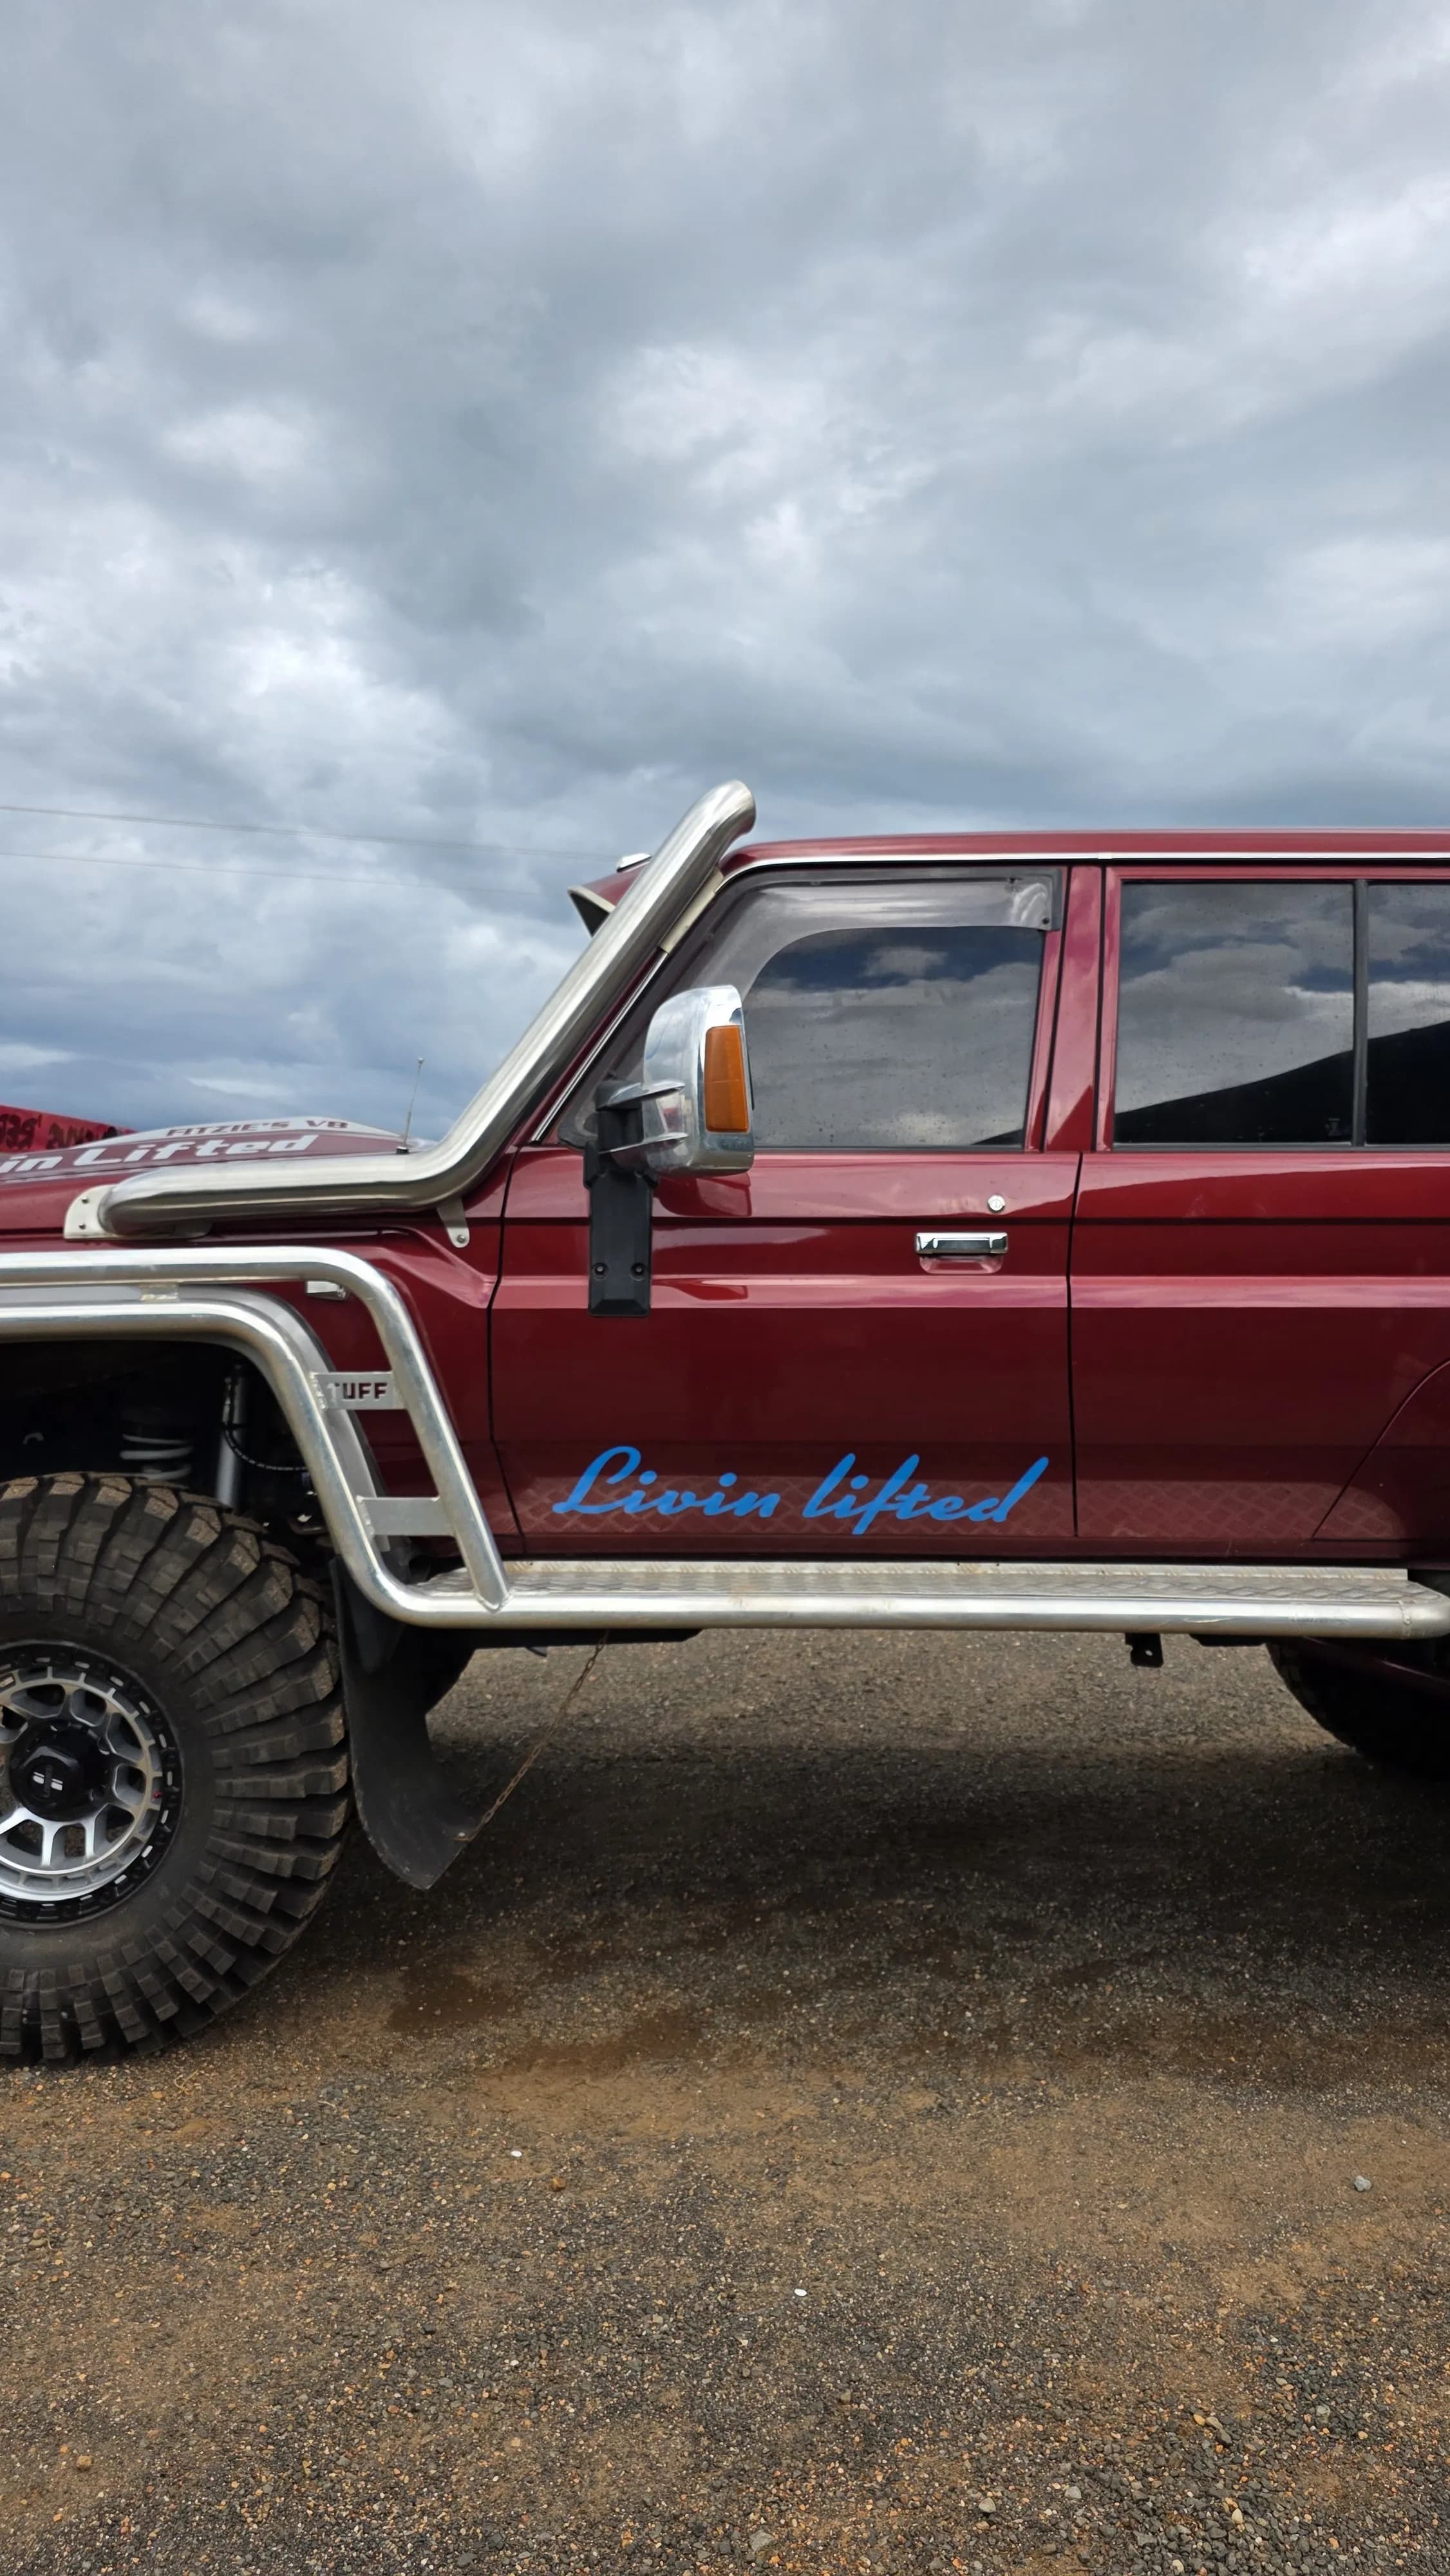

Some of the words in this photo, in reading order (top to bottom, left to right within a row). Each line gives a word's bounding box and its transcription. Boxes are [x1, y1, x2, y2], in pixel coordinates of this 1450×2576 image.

[166, 1121, 290, 1137] FITZIE'S
[73, 1134, 319, 1166] Lifted
[326, 1382, 388, 1403] TUFF
[552, 1445, 780, 1518] Livin
[802, 1452, 1050, 1535] lifted
